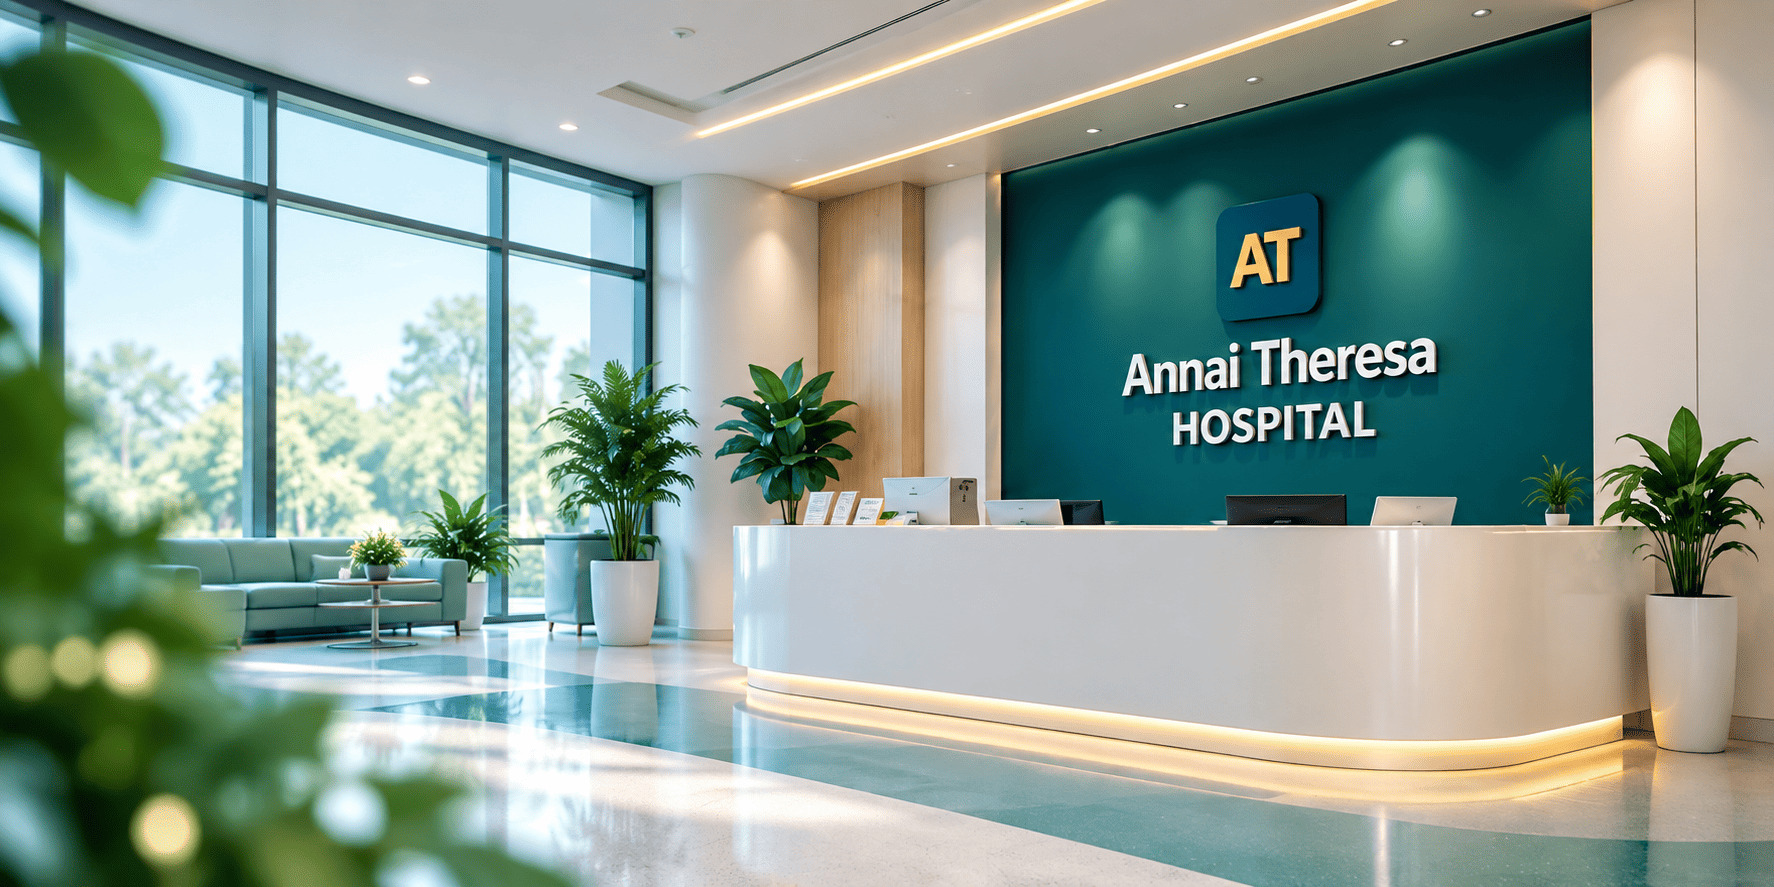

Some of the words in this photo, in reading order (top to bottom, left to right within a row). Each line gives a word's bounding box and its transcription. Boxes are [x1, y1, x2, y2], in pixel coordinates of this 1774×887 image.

[1229, 226, 1302, 289] AT
[1121, 343, 1241, 397] Annai
[1250, 337, 1438, 386] Theresa
[1172, 400, 1377, 446] HOSPITAL
